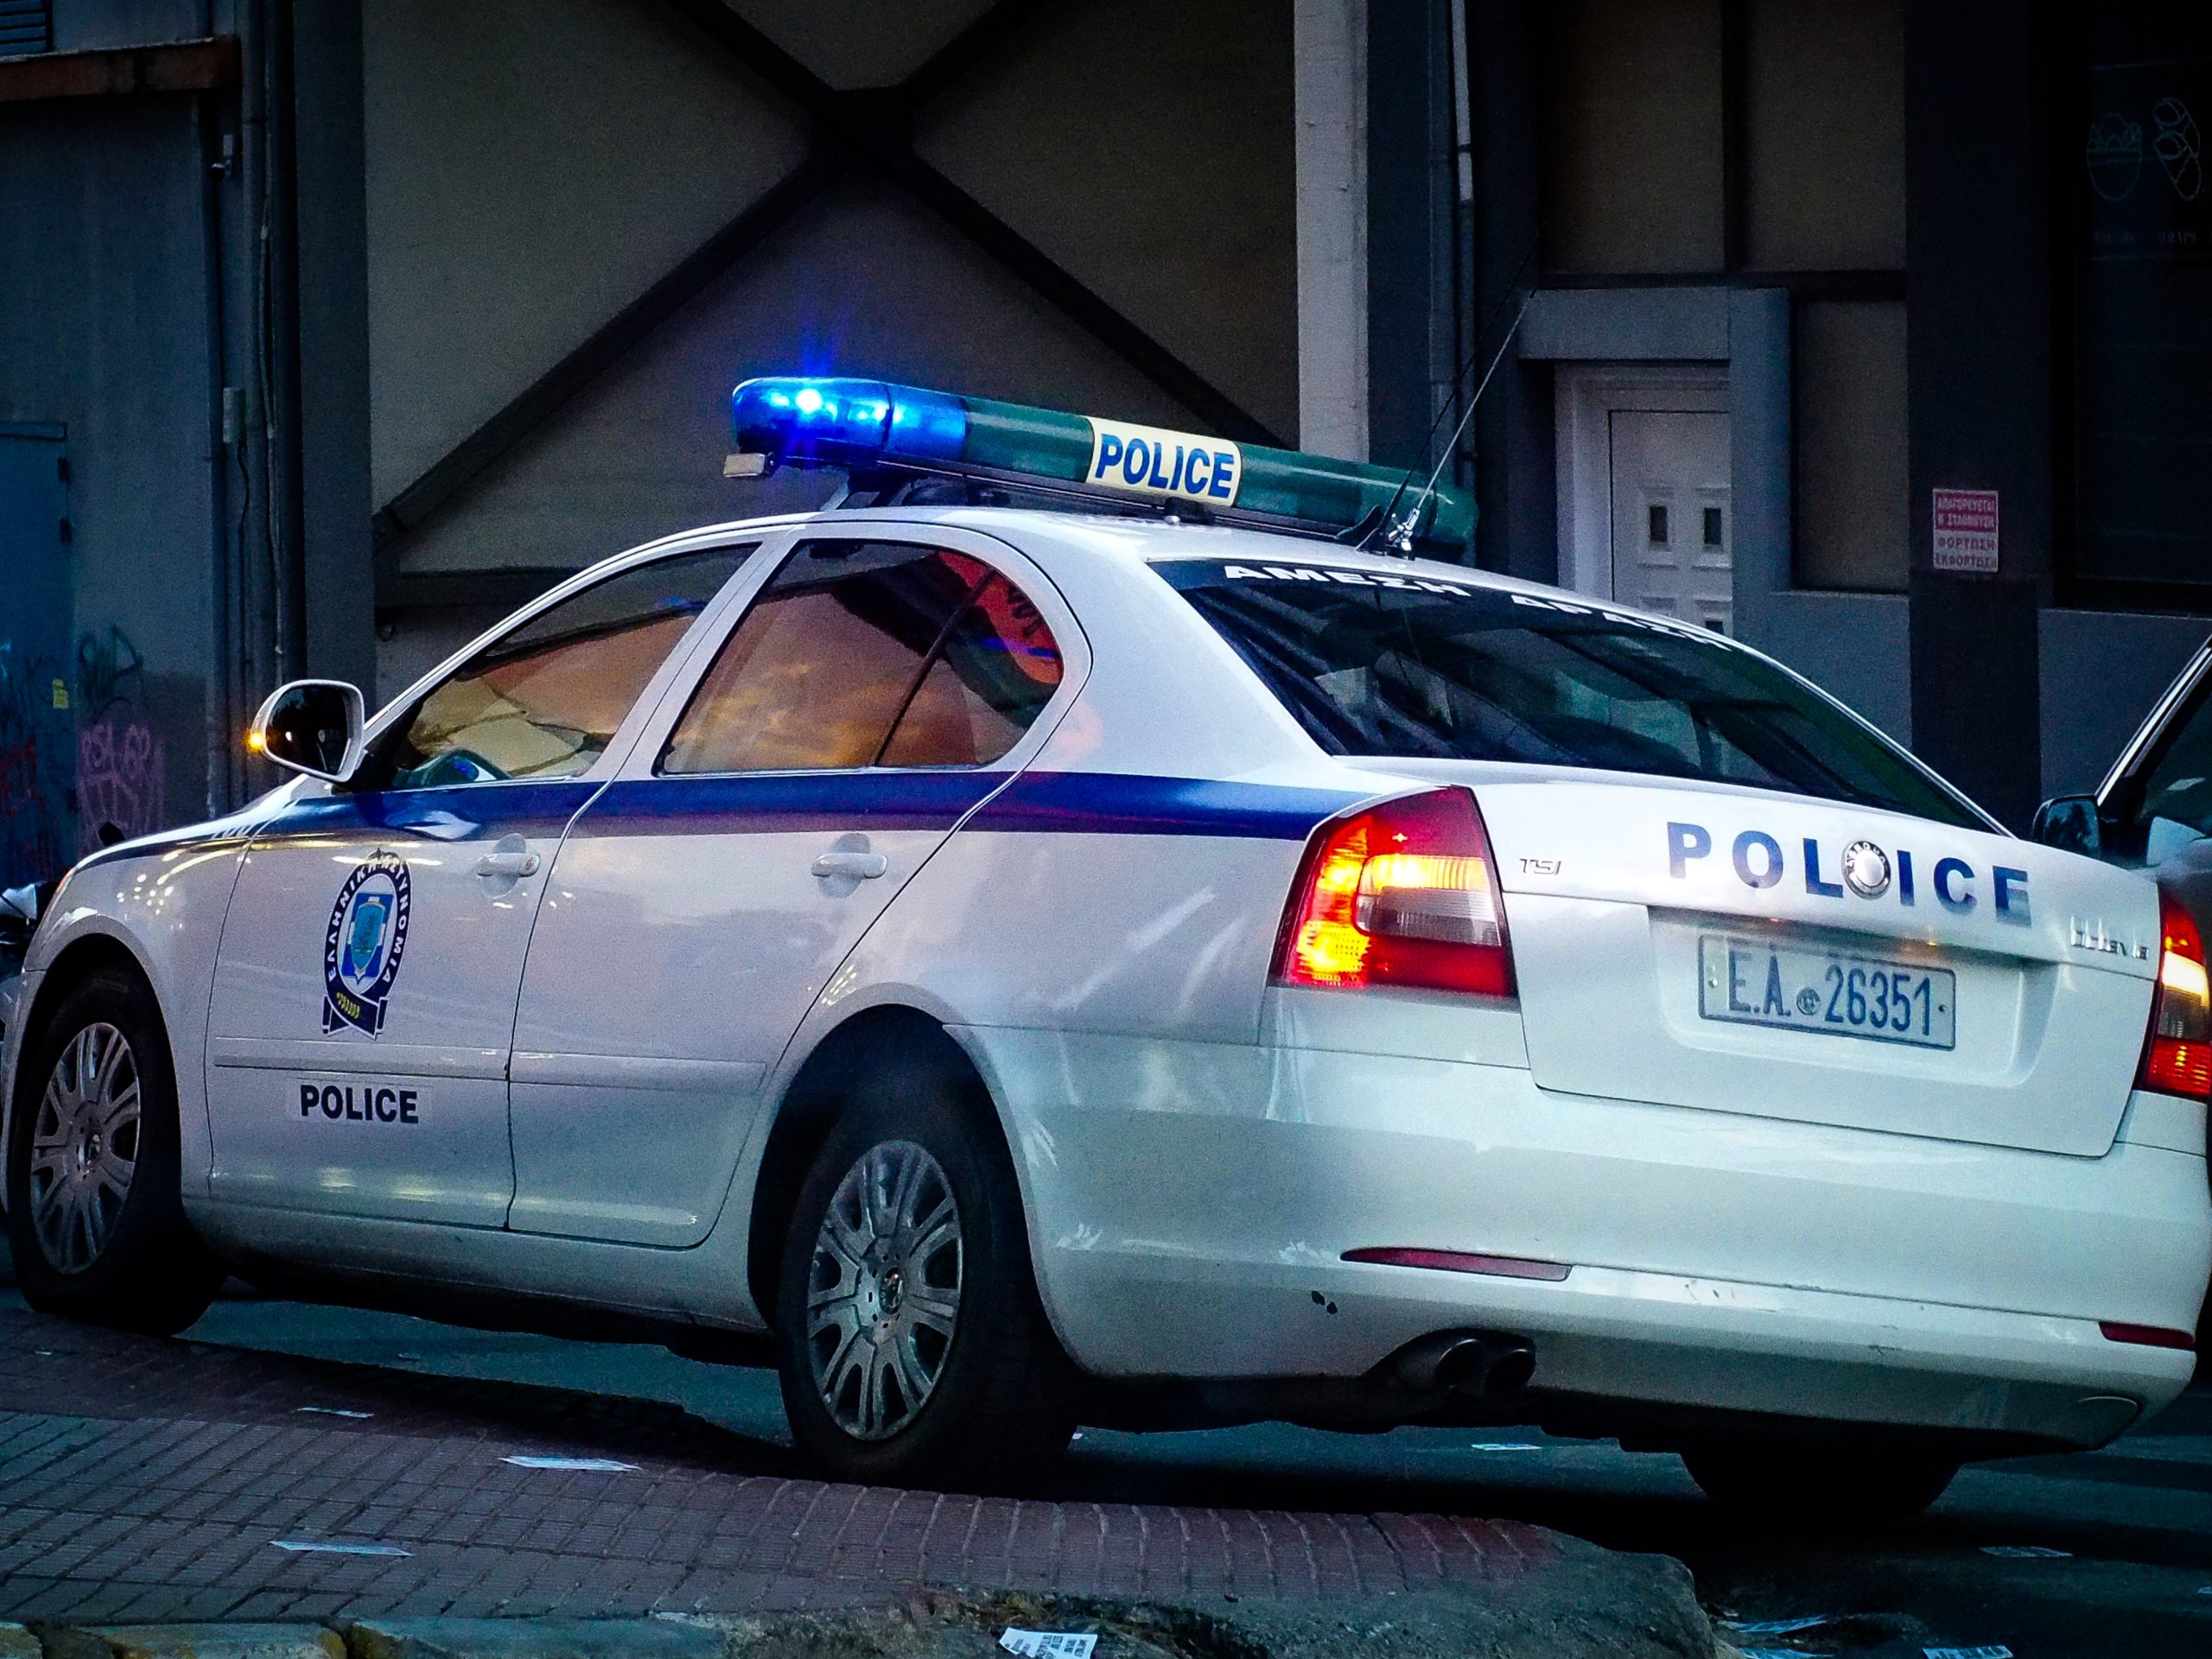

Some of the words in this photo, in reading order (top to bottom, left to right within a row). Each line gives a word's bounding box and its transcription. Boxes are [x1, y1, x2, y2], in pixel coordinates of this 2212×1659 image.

[1095, 433, 1235, 499] POLICE
[1667, 821, 2032, 928] POLICE
[1825, 963, 1930, 1036] 26351
[300, 1084, 419, 1125] POLICE
